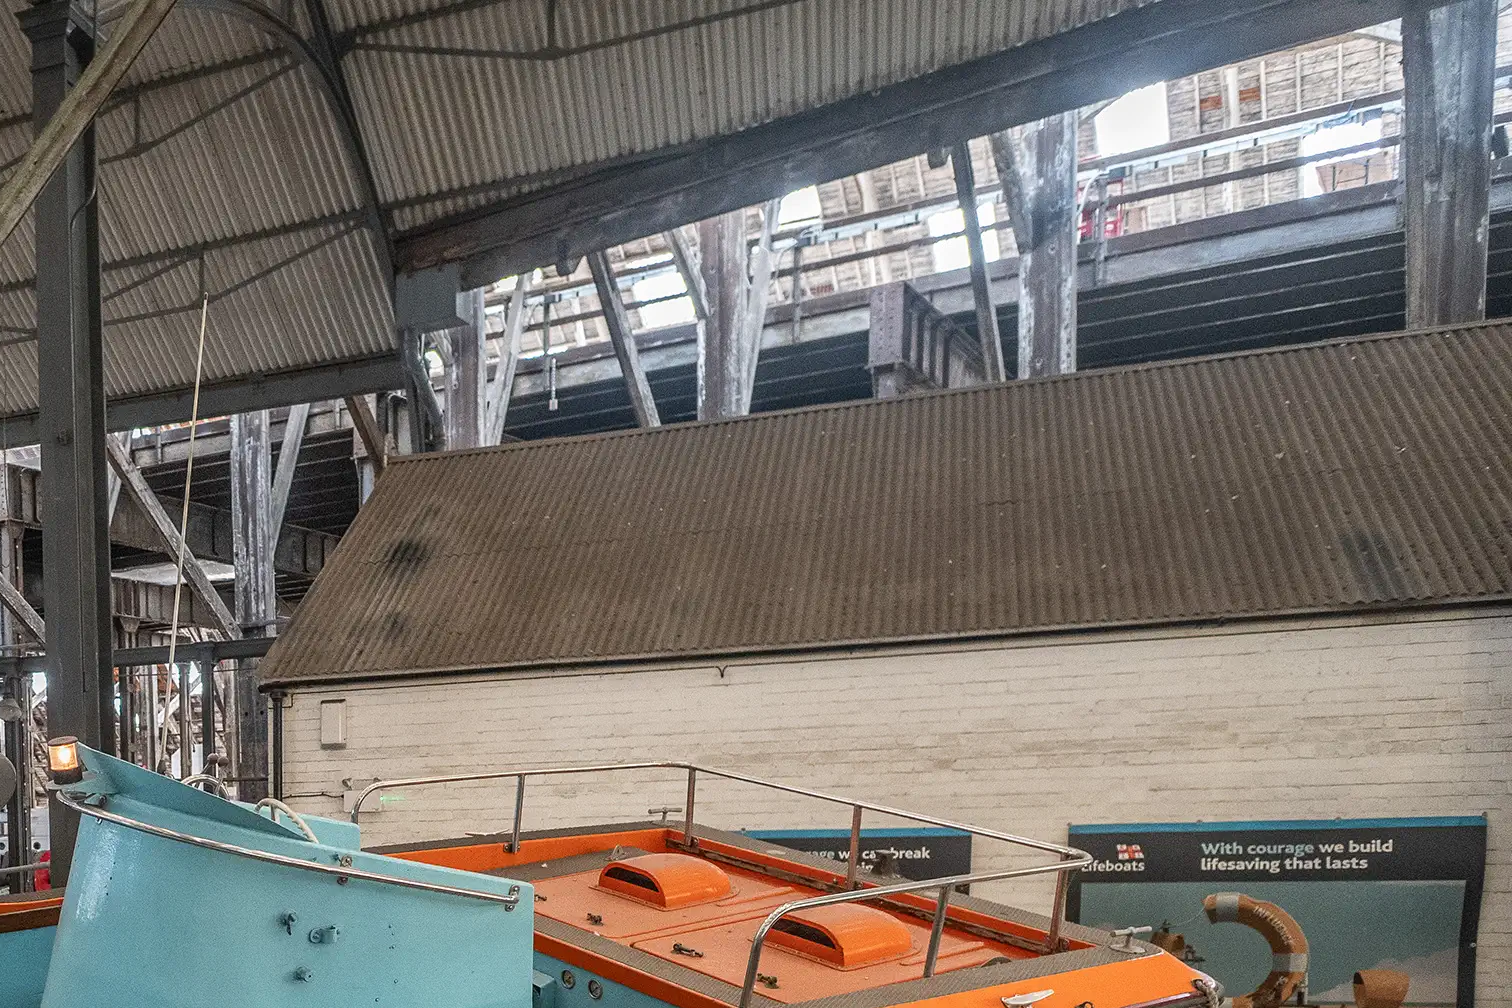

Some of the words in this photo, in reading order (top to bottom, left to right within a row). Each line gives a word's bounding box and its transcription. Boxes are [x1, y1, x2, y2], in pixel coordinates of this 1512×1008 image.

[1201, 842, 1243, 855] With
[1247, 843, 1314, 858] courage
[1319, 843, 1345, 854] we
[1349, 840, 1394, 853] build
[1201, 857, 1281, 874] lifesaving
[1284, 857, 1321, 871] that
[1326, 856, 1369, 871] lasts
